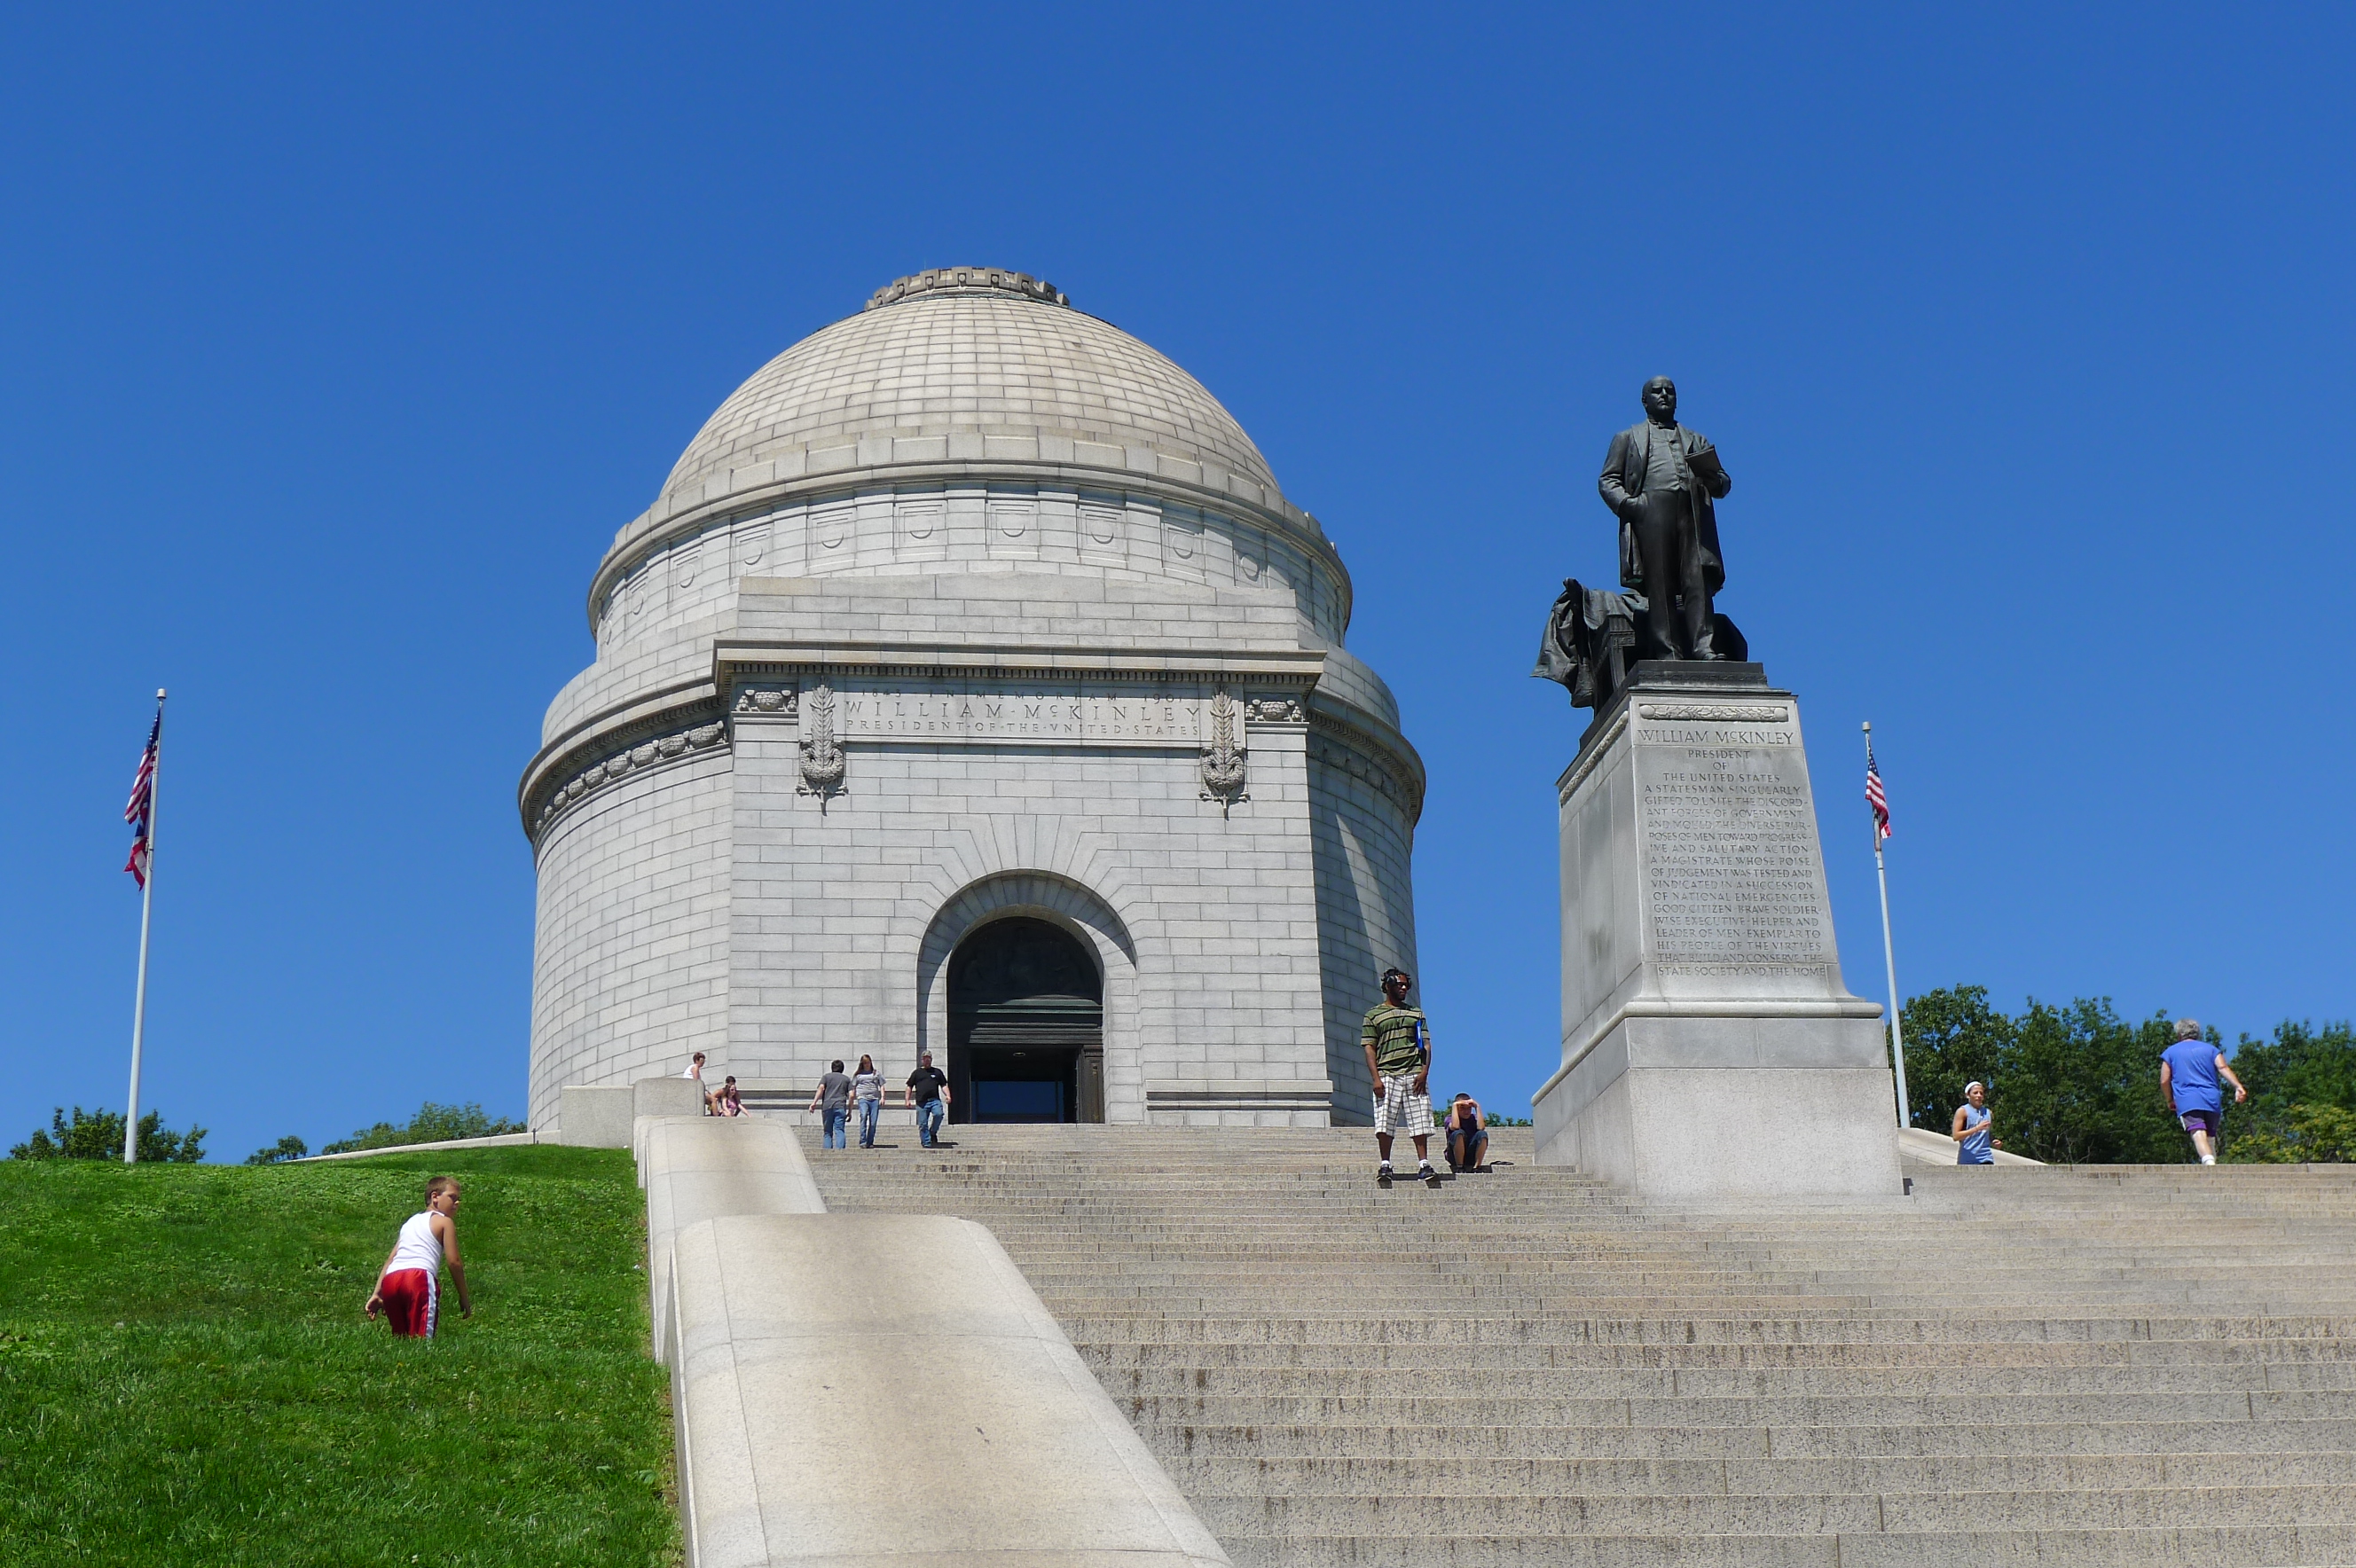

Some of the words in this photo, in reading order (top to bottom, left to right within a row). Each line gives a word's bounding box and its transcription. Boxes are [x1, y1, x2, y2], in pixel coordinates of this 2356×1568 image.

[929, 689, 954, 698] IN
[976, 690, 1117, 702] MEMORIAM
[1143, 693, 1182, 704] 1901
[845, 702, 1003, 718] WILLIAM
[846, 720, 964, 731] PRESIDENT
[975, 722, 996, 732] OF
[1007, 723, 1039, 733] THE
[1134, 725, 1198, 735] STATES
[1637, 729, 1708, 743] WILLIAM
[1688, 749, 1751, 759] PRESIDENT
[1663, 772, 1685, 781] THE
[1691, 773, 1734, 782] UNITED
[1739, 774, 1780, 783] STATES
[1656, 785, 1724, 794] STATESMAN
[1729, 786, 1801, 795] SINGULARLY
[1645, 796, 1683, 805] GIFTED
[1685, 796, 1700, 805] TO
[1702, 797, 1732, 806] UNITE
[1734, 797, 1755, 806] THE
[1646, 808, 1668, 817] ANT
[1671, 808, 1711, 818] FORCES
[1713, 809, 1728, 818] OF
[1731, 809, 1803, 819] GOVERNMENT
[1673, 820, 1712, 829] MOULD
[1742, 821, 1782, 830] DIVERSE
[1717, 833, 1758, 842] TOWARD
[1650, 844, 1668, 853] IVE
[1672, 844, 1696, 853] AND
[1700, 844, 1760, 854] SALUTARY
[1764, 844, 1809, 854] ACTION
[1661, 857, 1732, 866] MAGISTRATE
[1735, 857, 1775, 866] WHOSE
[1779, 857, 1811, 866] POISE
[1651, 867, 1665, 877] OF
[1666, 868, 1728, 878] JUDGEMENT
[1730, 868, 1751, 877] WAS
[1753, 869, 1790, 878] TESTED
[1791, 869, 1813, 878] AND
[1651, 880, 1718, 890] VINDICATED
[1747, 882, 1813, 890] SUCCESSION
[1653, 892, 1669, 901] OF
[1672, 892, 1731, 902] NATIONAL
[1653, 905, 1686, 913] GOOD
[1688, 905, 1732, 913] CITIZEN
[1738, 905, 1770, 913] BRAVE
[1653, 916, 1682, 925] WISE
[1795, 917, 1818, 927] AND
[1656, 929, 1697, 937] LEADER
[1700, 929, 1713, 937] OF
[1804, 929, 1821, 939] TO
[1657, 941, 1677, 950] HIS
[1680, 941, 1724, 950] PEOPLE
[1747, 942, 1769, 951] THE
[1771, 942, 1822, 952] VIRTUES
[1657, 953, 1685, 962] THAT
[1690, 953, 1720, 962] BUILD
[1723, 953, 1745, 962] AND
[1746, 953, 1800, 963] CONSERVE
[1803, 954, 1824, 963] THE
[1658, 967, 1691, 976] STATE
[1694, 967, 1744, 976] SOCIETY
[1744, 968, 1766, 976] AND
[1768, 968, 1790, 976] THE
[1793, 968, 1826, 976] HOME
